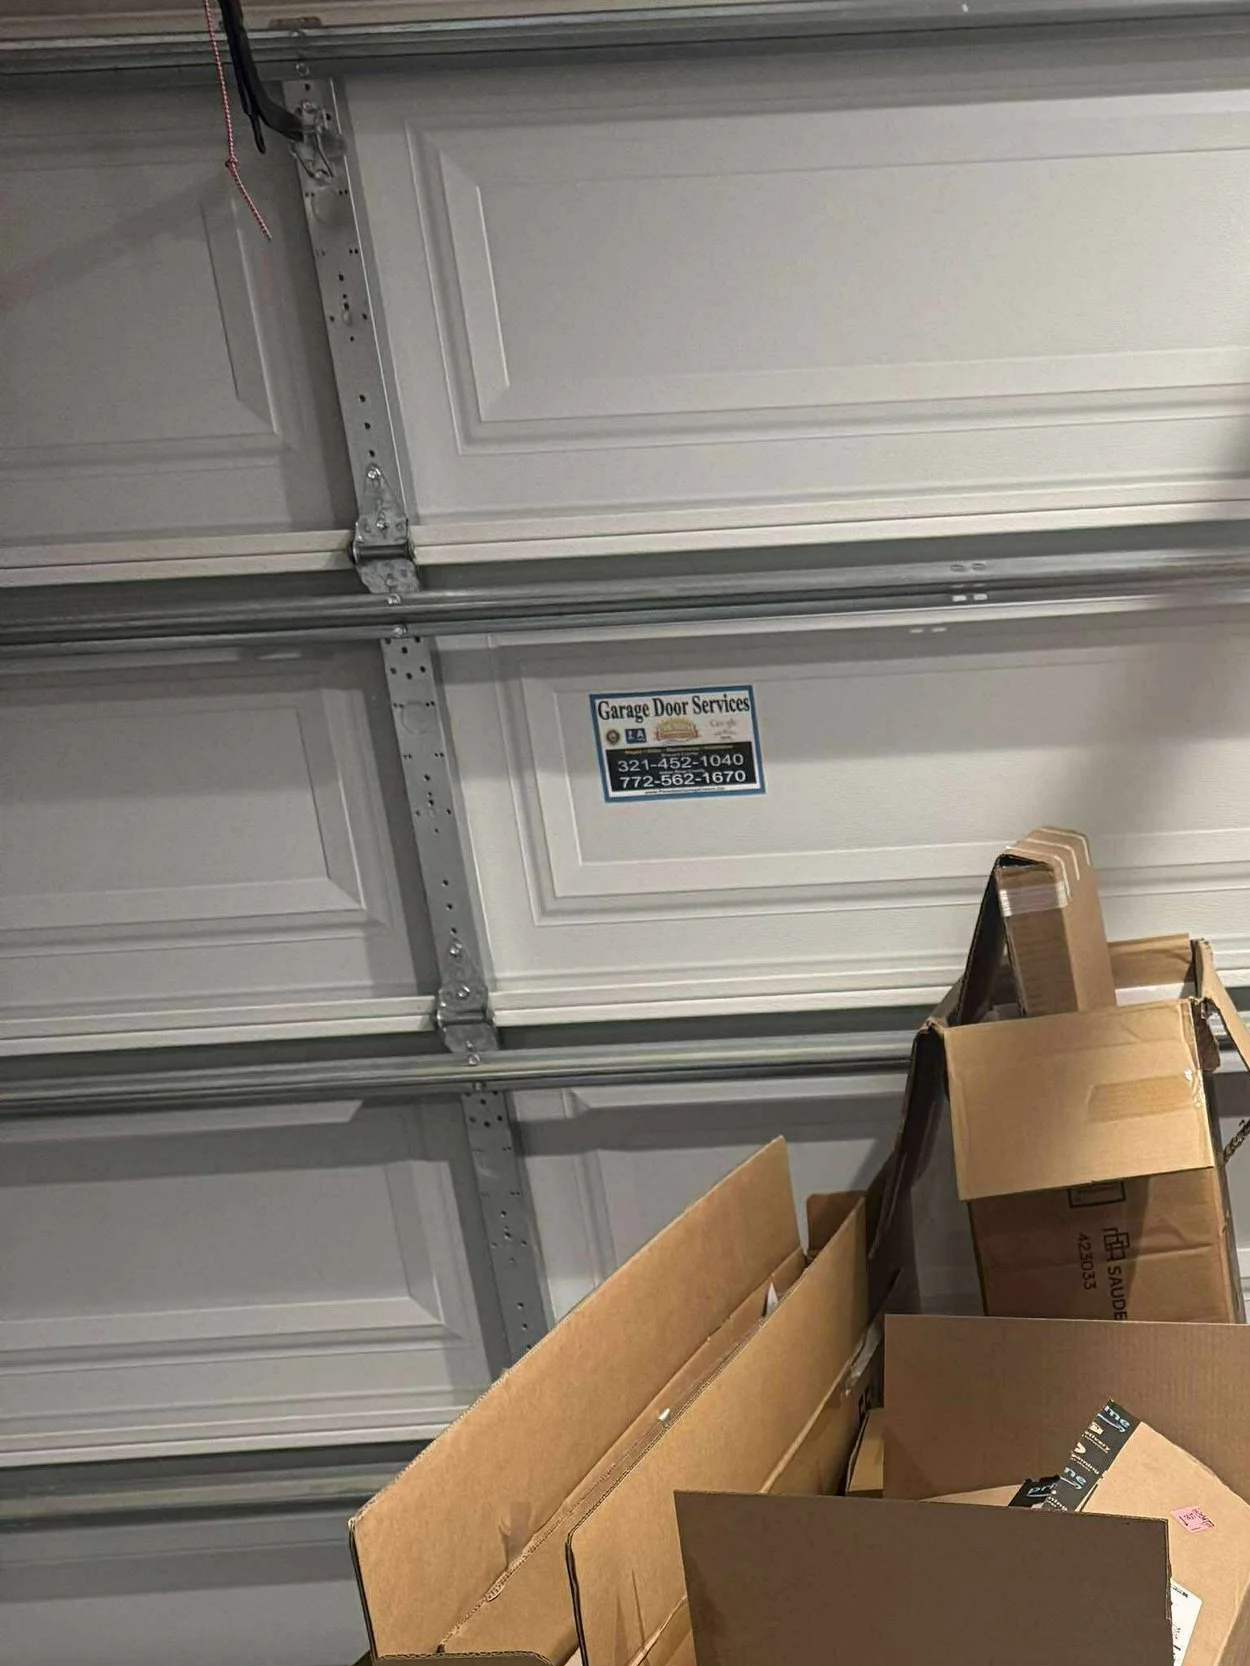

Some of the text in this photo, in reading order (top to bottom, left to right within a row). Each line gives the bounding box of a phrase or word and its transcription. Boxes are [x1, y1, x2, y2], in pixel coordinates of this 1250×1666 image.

[598, 694, 750, 723] Garage Door Services
[618, 754, 744, 773] 321-452-1040
[620, 771, 746, 789] 772-562-1670
[1076, 1232, 1097, 1291] 423033
[1107, 1265, 1128, 1320] SAUDE
